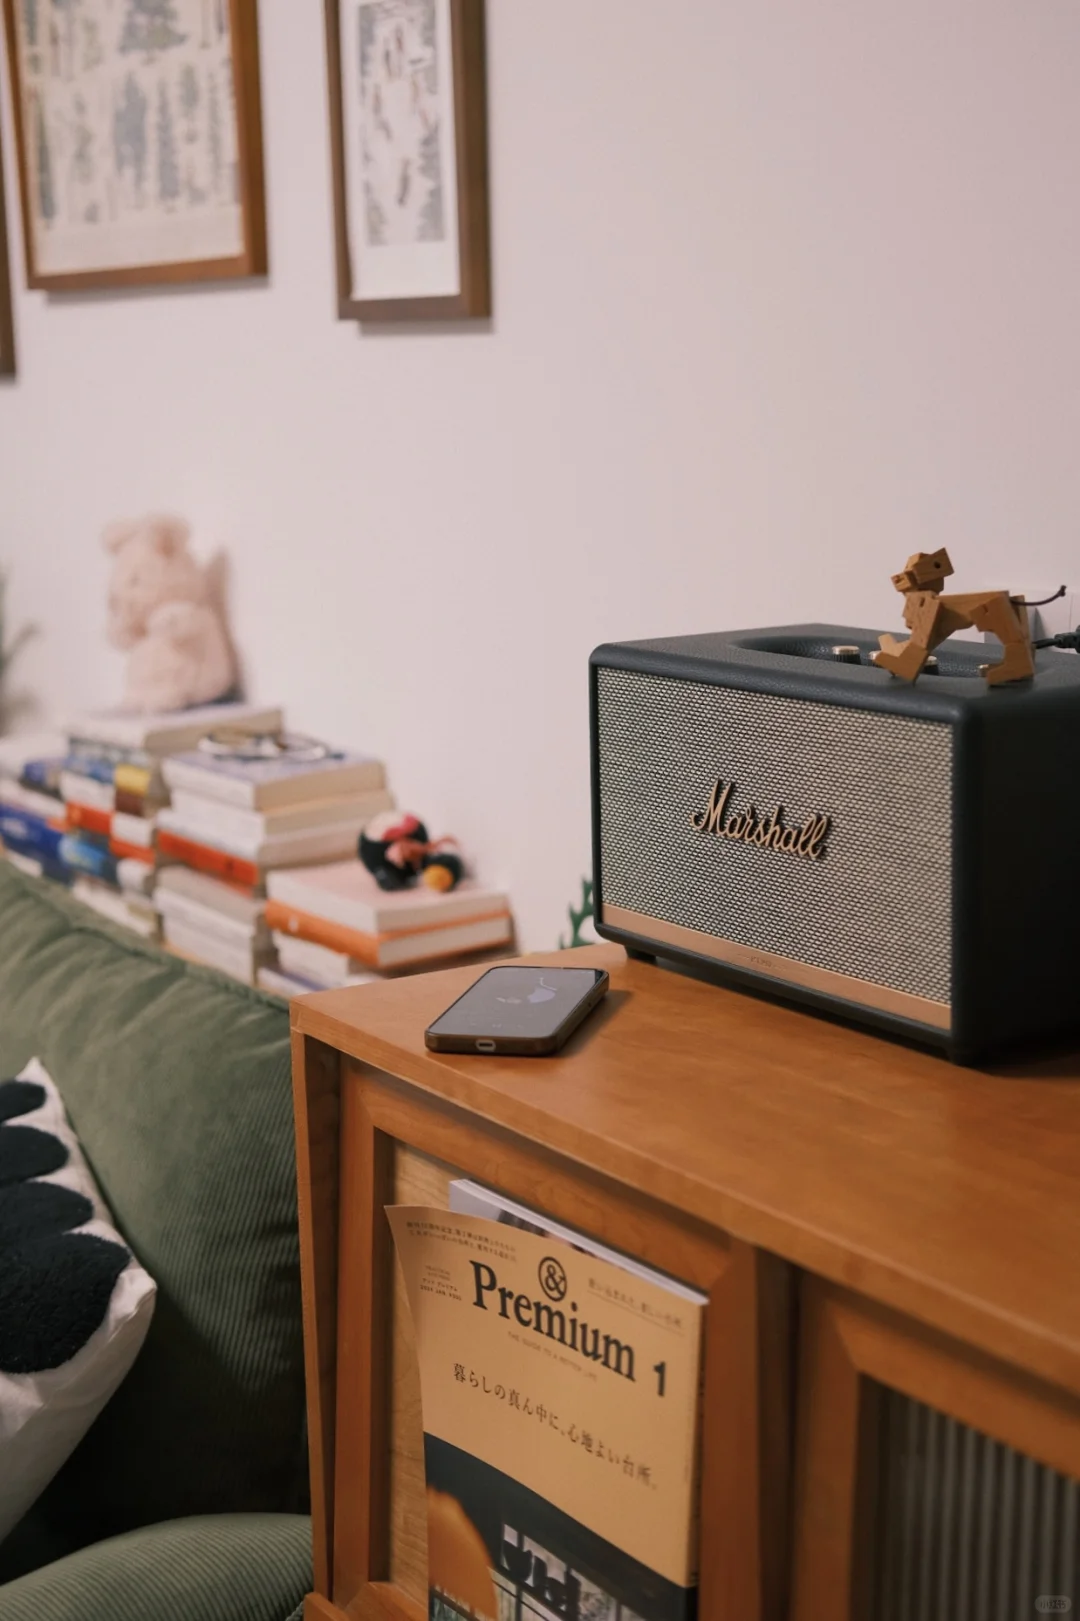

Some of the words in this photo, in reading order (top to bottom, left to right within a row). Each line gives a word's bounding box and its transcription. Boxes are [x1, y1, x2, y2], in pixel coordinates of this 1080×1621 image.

[690, 778, 829, 859] Marshall
[543, 1259, 566, 1299] &
[469, 1260, 636, 1382] Premium
[653, 1361, 667, 1396] 1
